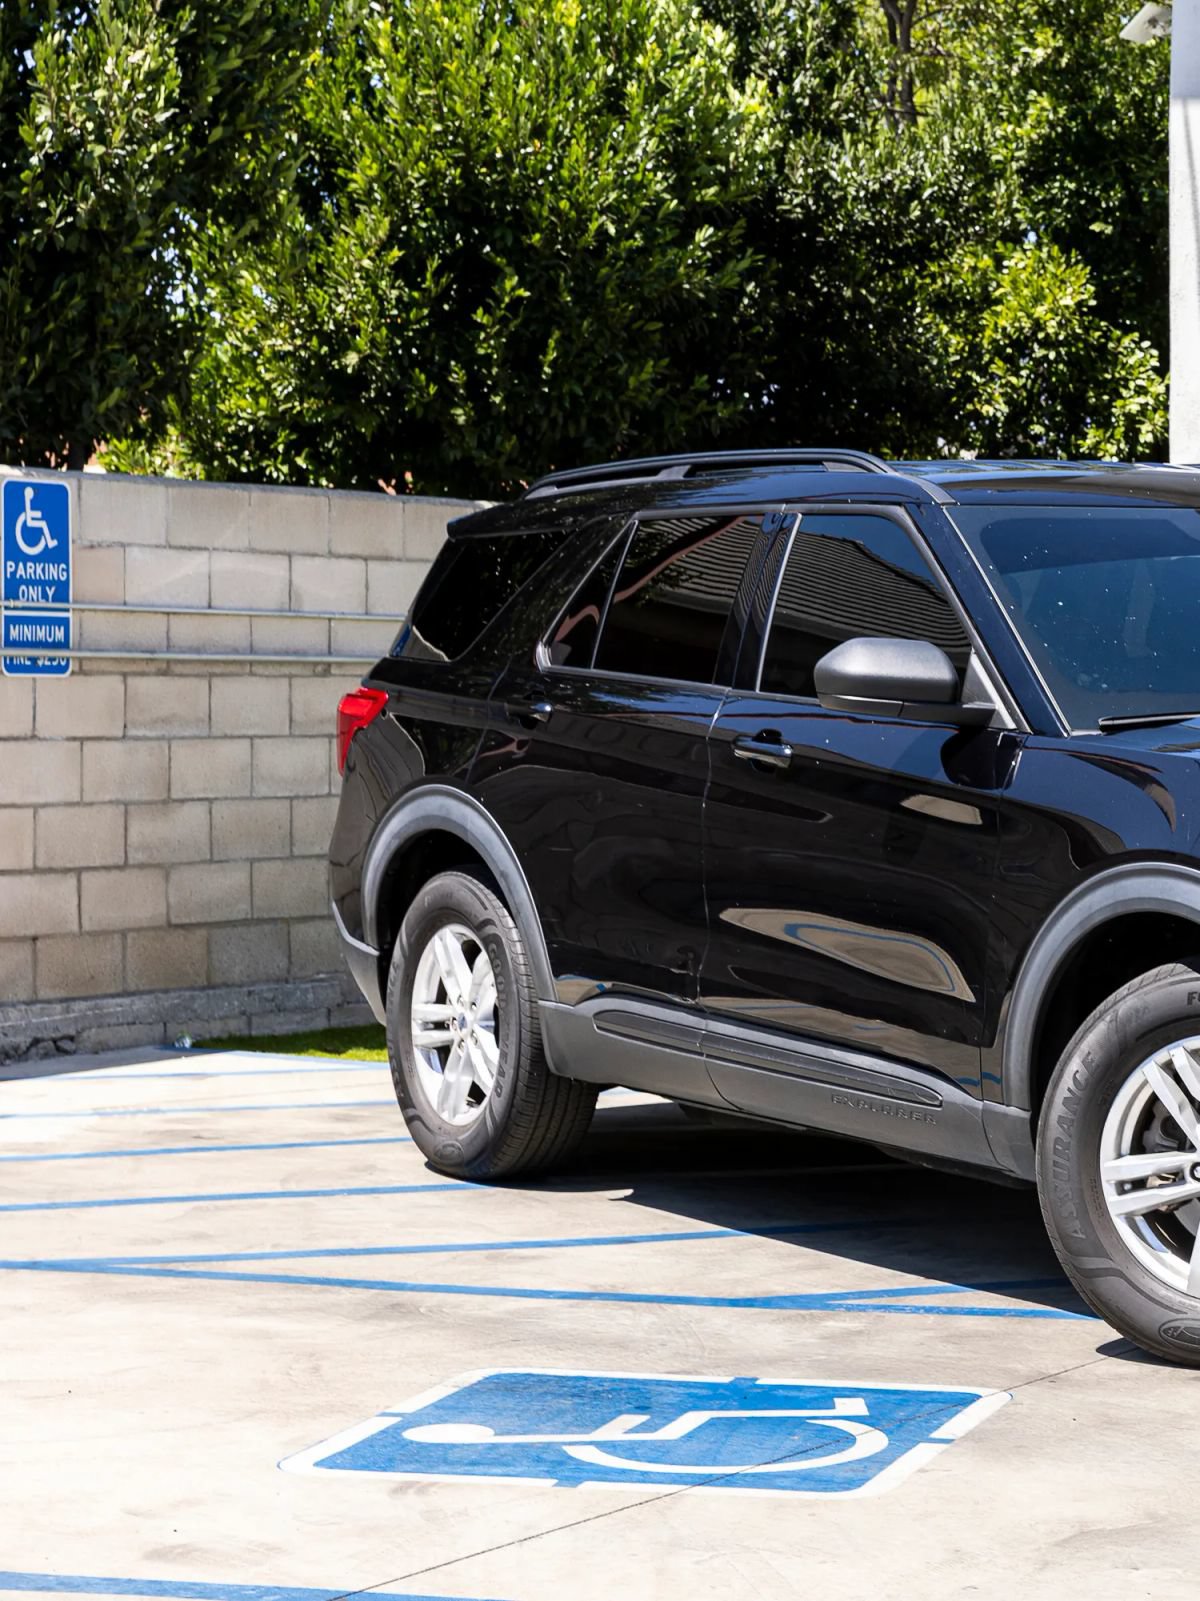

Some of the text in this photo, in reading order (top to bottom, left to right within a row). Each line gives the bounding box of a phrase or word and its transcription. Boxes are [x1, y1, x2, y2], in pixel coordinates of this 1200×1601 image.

[6, 560, 68, 581] PARKING
[18, 584, 56, 602] ONLY
[9, 623, 65, 642] MINIMUM
[1052, 1050, 1096, 1240] ASSURANCE
